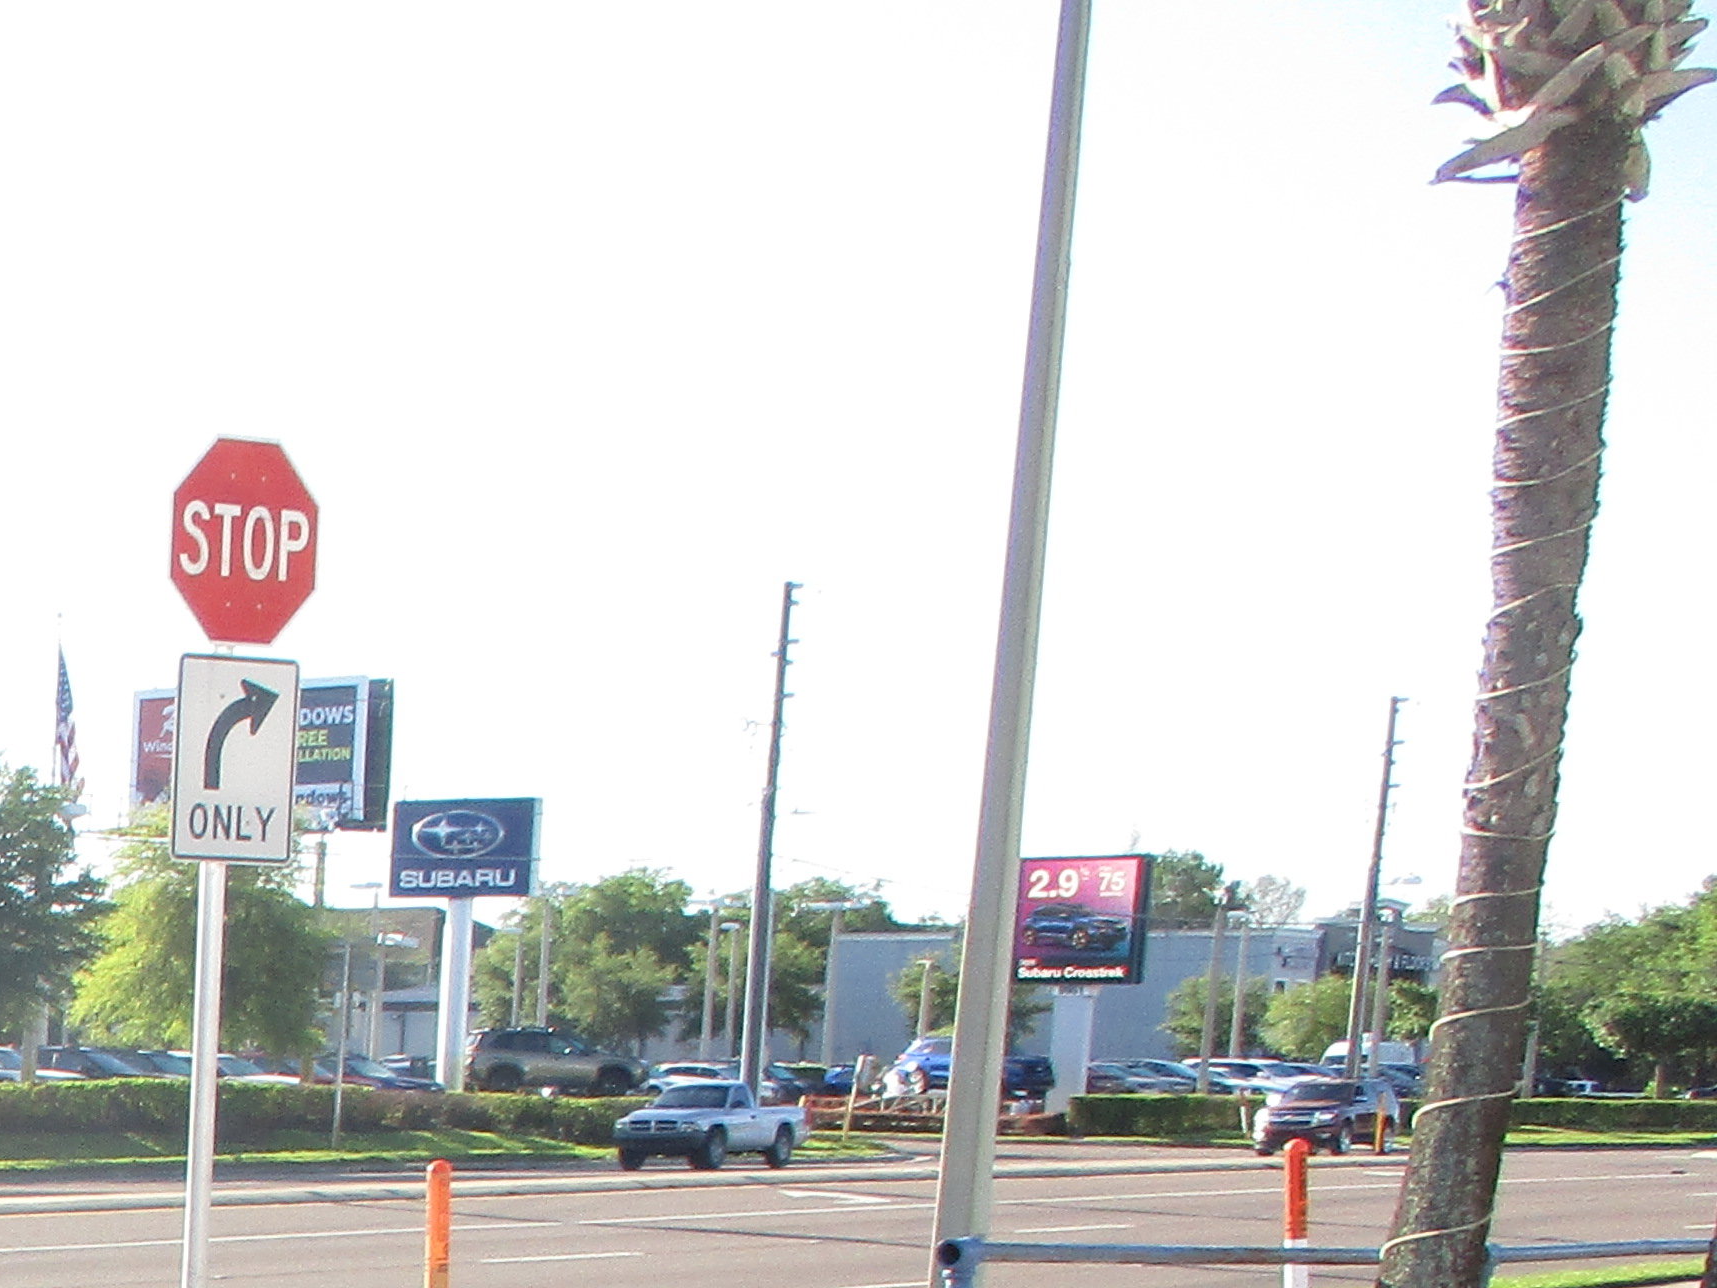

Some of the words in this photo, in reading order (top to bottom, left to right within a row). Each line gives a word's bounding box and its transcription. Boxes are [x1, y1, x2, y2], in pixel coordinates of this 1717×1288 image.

[179, 499, 310, 581] STOP
[189, 803, 277, 843] ONLY
[399, 868, 516, 888] SUBARU
[1027, 868, 1080, 898] 2.9
[1098, 871, 1126, 891] 75
